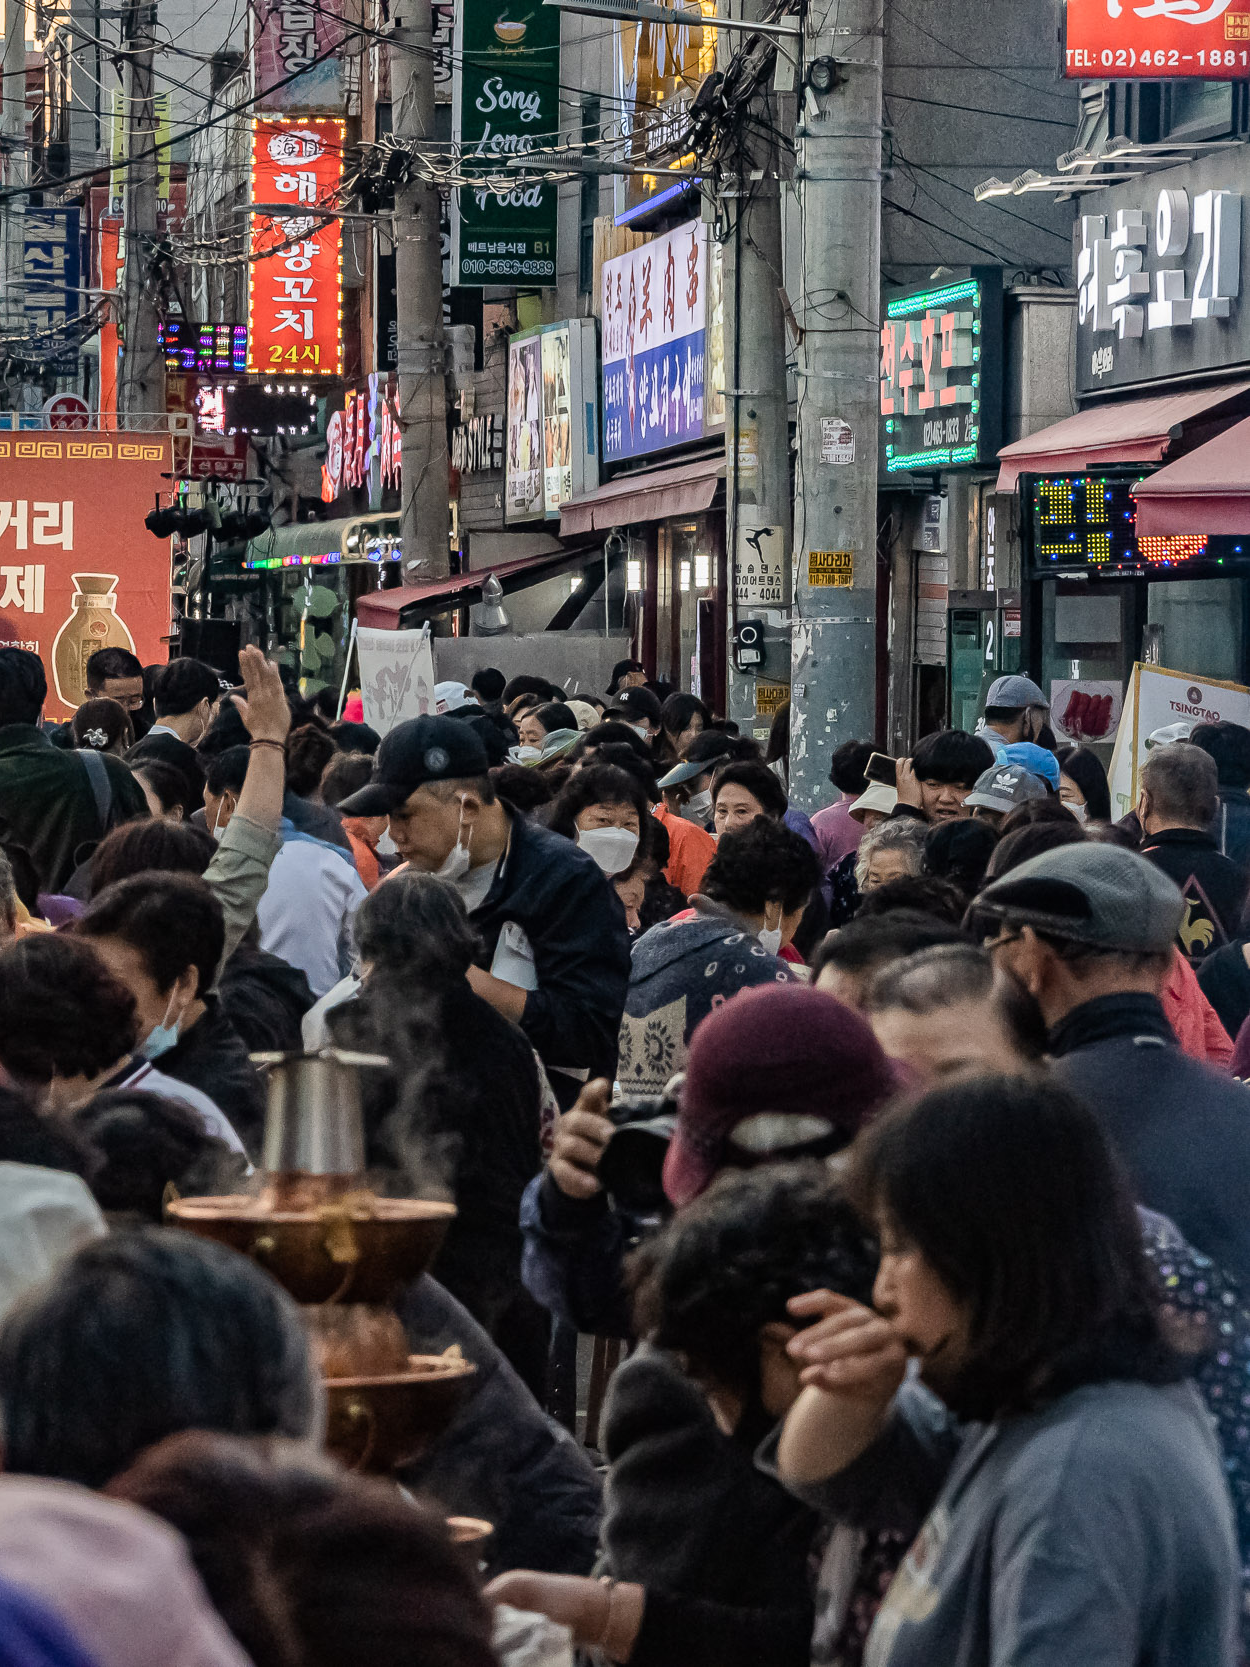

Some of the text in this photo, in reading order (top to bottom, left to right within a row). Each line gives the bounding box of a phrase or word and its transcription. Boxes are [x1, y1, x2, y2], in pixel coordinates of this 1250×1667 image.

[1066, 48, 1248, 67] TEL: 02)462-1881
[476, 77, 542, 122] Song
[467, 241, 550, 254] 베트남음식점 B1
[461, 258, 555, 276] 010-5696-9889
[268, 344, 320, 365] 24시
[638, 345, 693, 440] 양꼬치구이
[818, 553, 852, 567] 사다리차
[759, 588, 781, 601] 4044
[1169, 700, 1221, 723] TSINGTAO
[991, 782, 1015, 794] adidas
